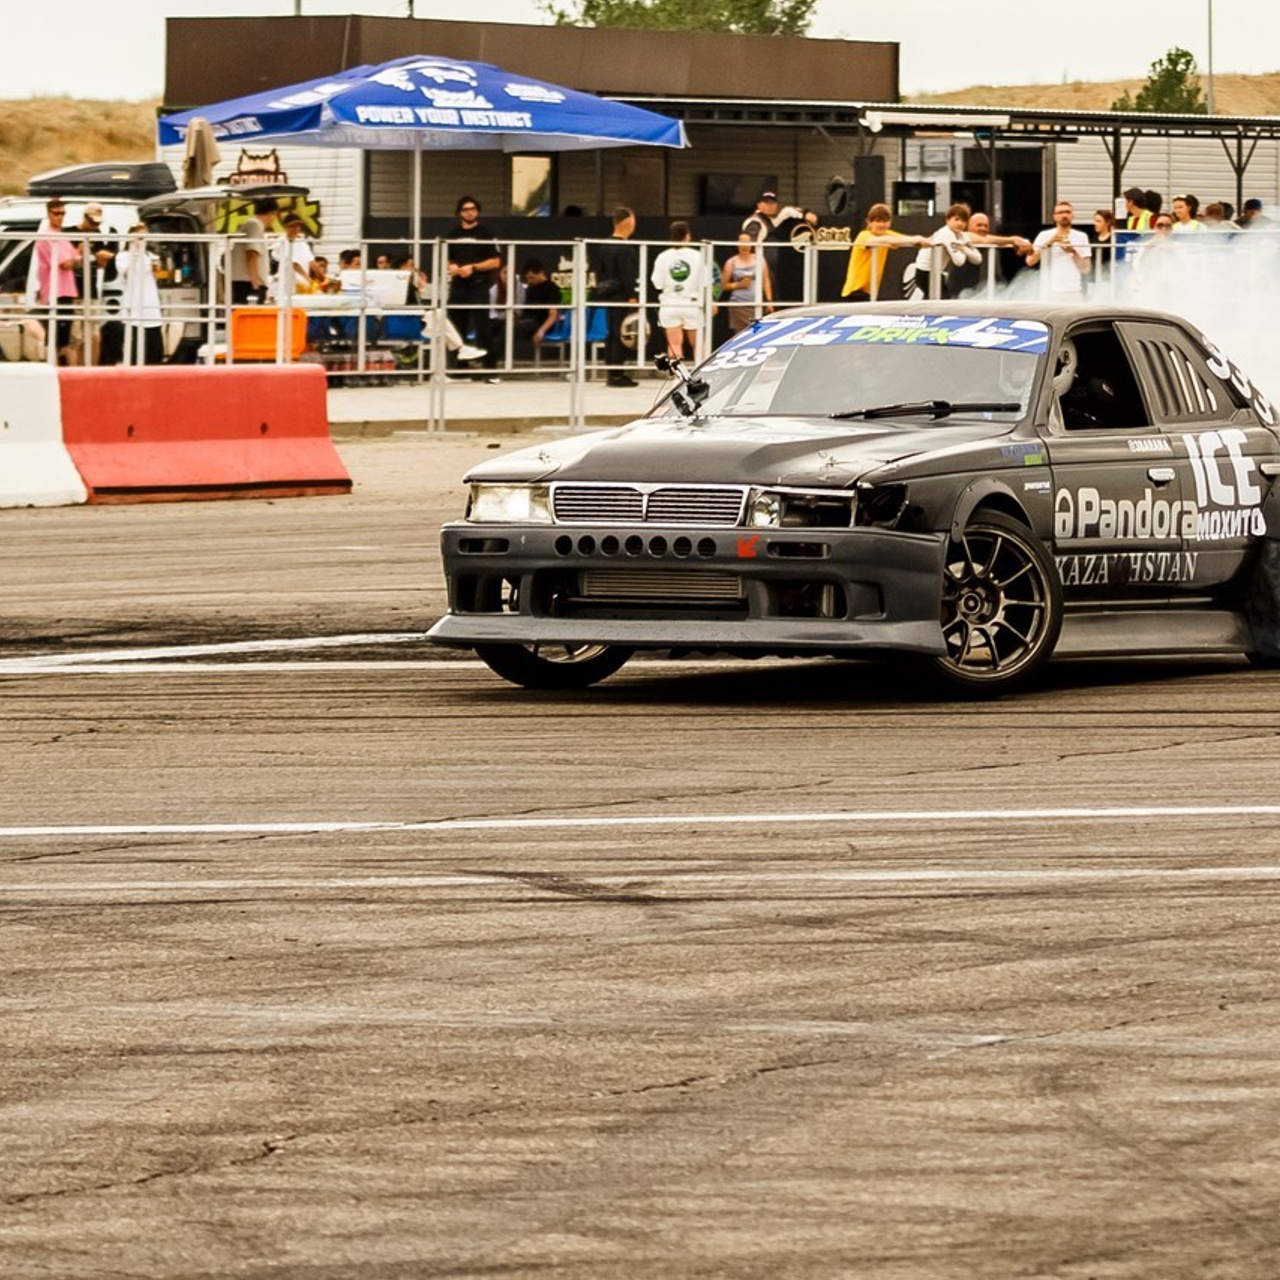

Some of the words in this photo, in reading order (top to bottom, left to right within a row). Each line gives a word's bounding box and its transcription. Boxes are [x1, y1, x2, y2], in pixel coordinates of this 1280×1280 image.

[355, 105, 415, 124] POWER
[414, 107, 460, 125] YOUR
[460, 110, 533, 128] INSTINCT
[701, 347, 777, 372] 333
[1183, 429, 1261, 508] ICE
[1077, 487, 1198, 539] Pandora
[1054, 552, 1198, 586] KAZAHSTAN
